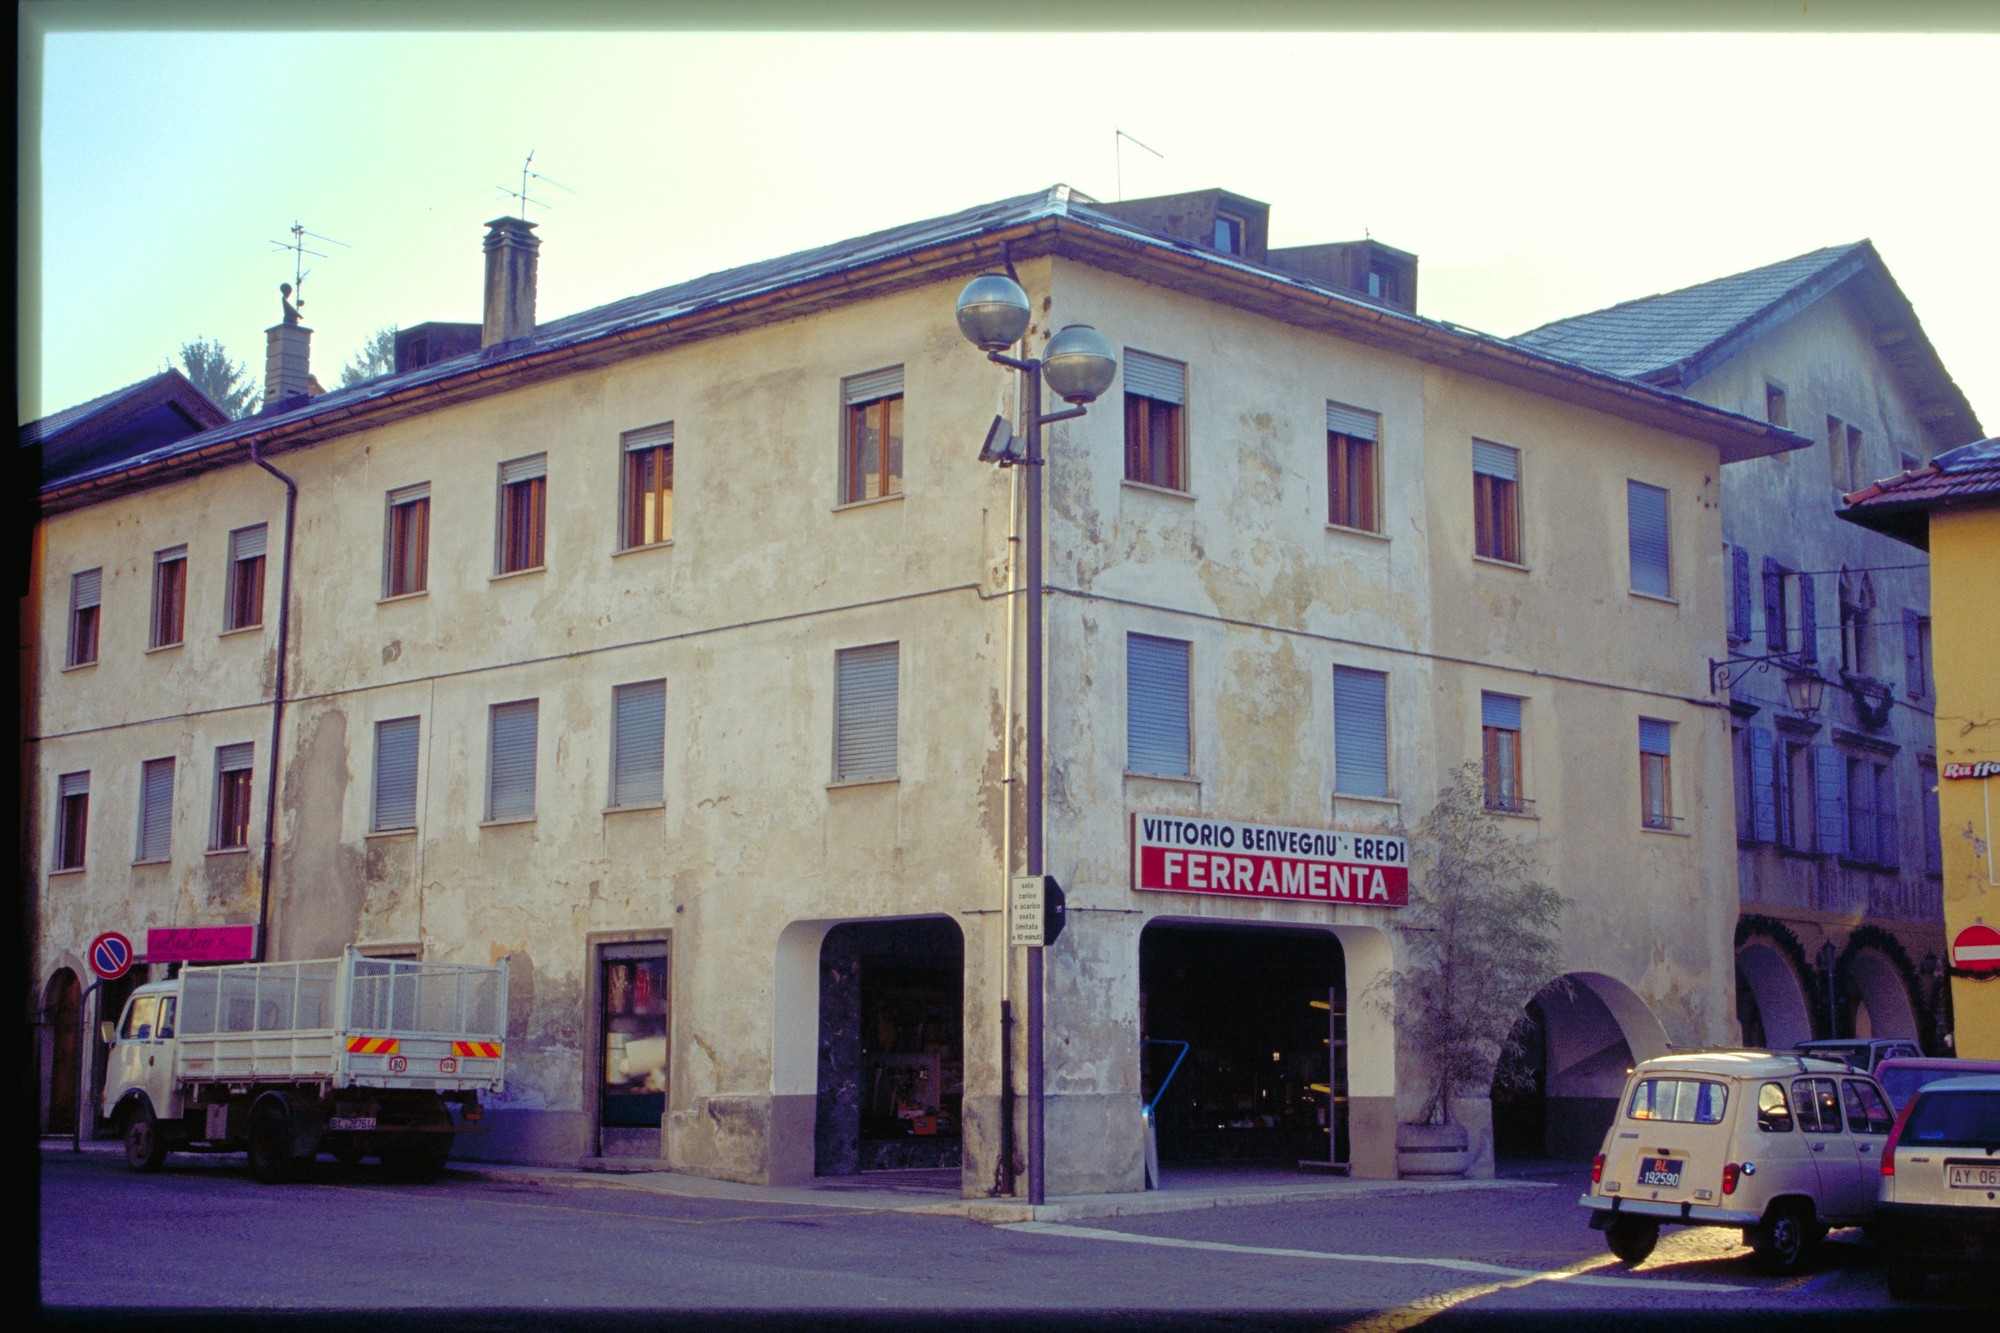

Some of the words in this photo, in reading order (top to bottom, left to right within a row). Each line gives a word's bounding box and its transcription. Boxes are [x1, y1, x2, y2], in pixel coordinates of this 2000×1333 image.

[1143, 819, 1234, 848] VITTORIO
[1355, 838, 1404, 862] EREDI
[1164, 852, 1388, 900] FERRAMENTA
[393, 1059, 403, 1069] 80
[1654, 1160, 1668, 1172] BL
[1645, 1172, 1679, 1185] 192590
[1955, 1170, 1970, 1183] AY
